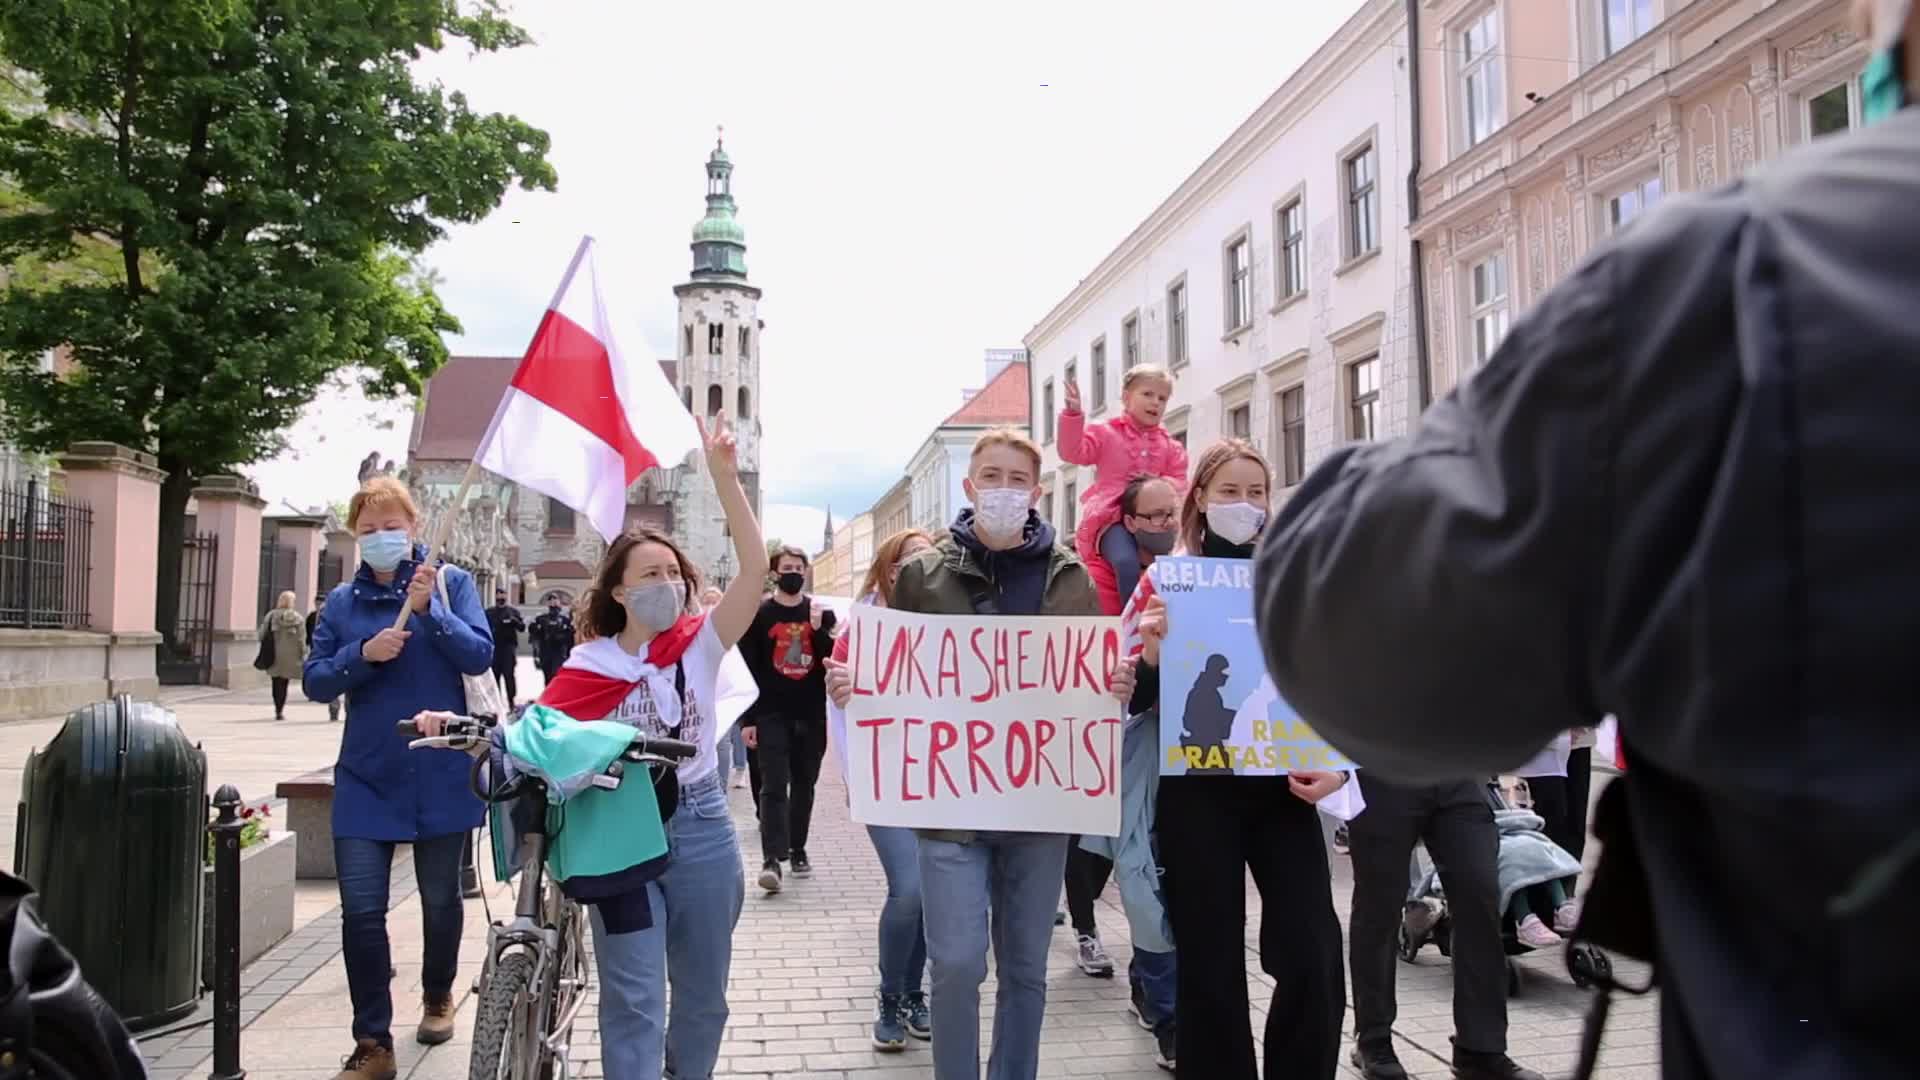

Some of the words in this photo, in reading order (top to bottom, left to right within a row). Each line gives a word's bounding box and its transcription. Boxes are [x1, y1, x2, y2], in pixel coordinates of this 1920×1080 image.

[1161, 584, 1194, 593] NOW
[850, 617, 1121, 702] LUKASHENKO
[1253, 720, 1320, 741] RAM
[856, 718, 1121, 800] TERRORIST
